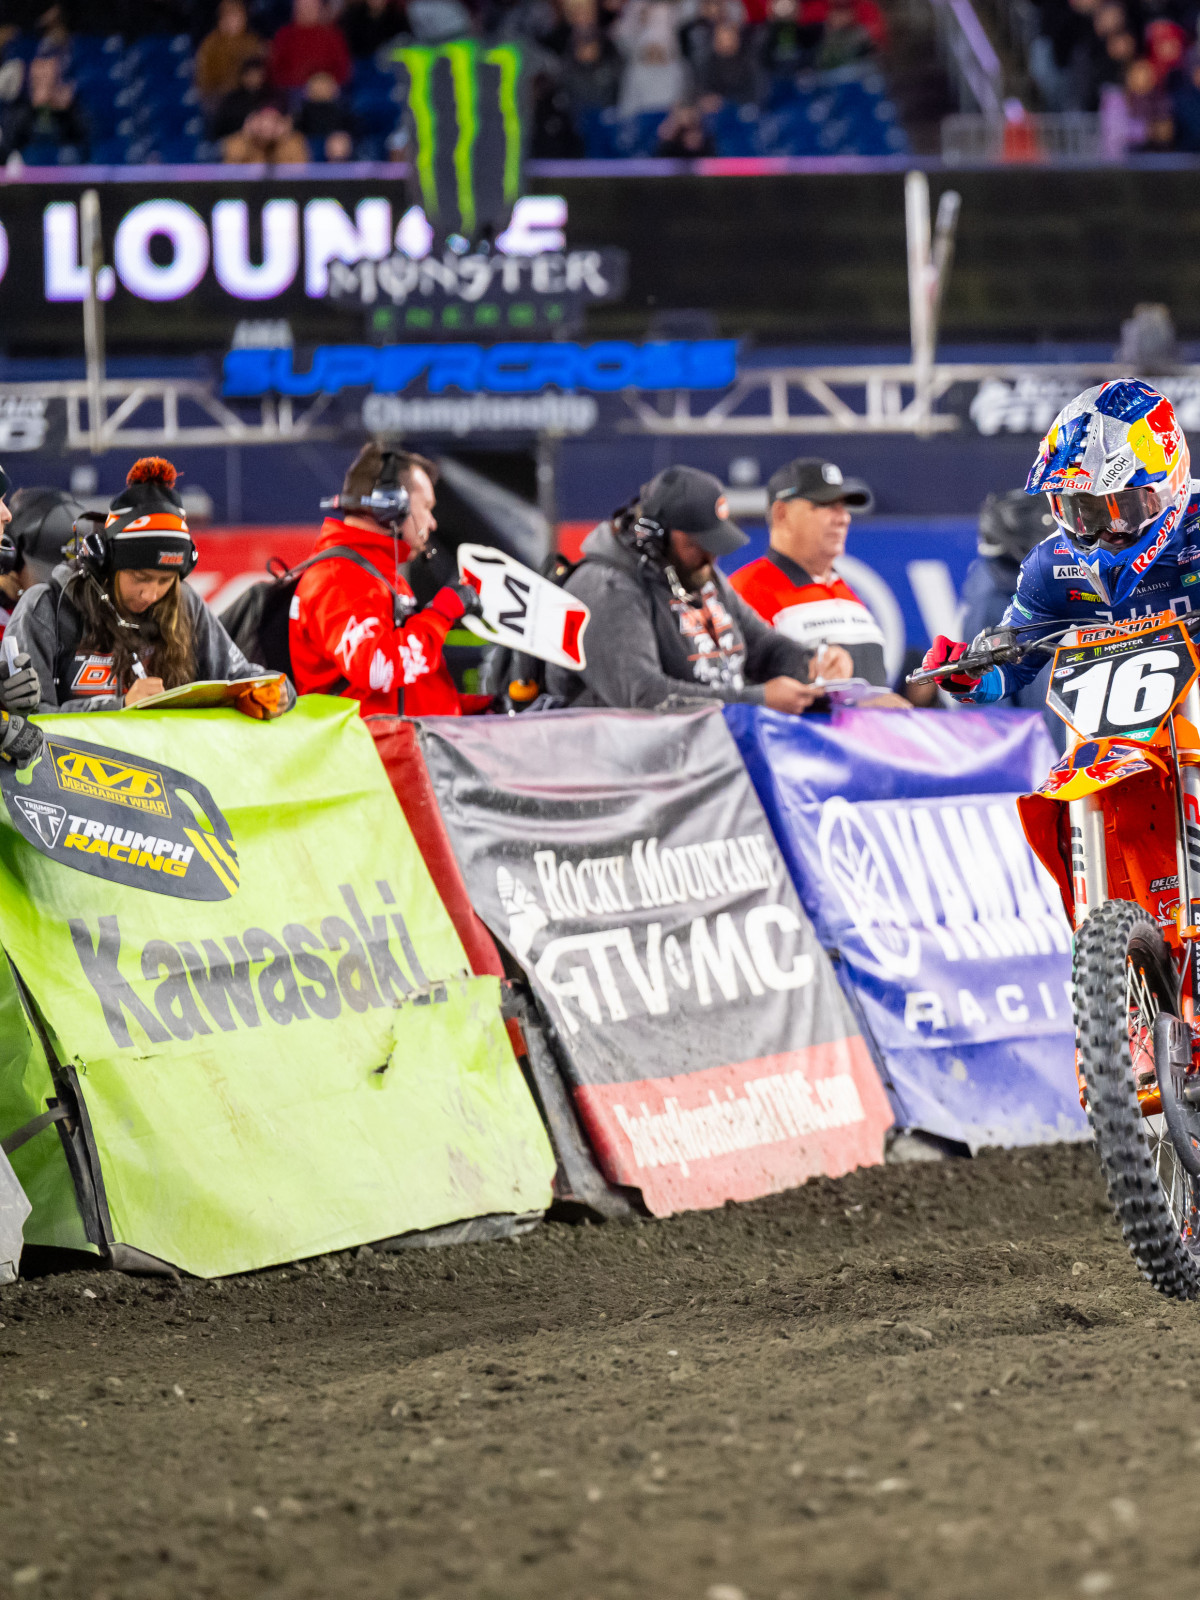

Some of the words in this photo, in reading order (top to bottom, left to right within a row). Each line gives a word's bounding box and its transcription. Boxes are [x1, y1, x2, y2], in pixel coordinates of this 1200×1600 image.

[328, 250, 606, 302] MONSTER
[1040, 479, 1065, 491] Red
[1066, 479, 1092, 491] Bull
[1102, 455, 1130, 488] AIROH
[1131, 527, 1168, 575] Red
[1081, 618, 1166, 644] RENTHAL
[1104, 638, 1144, 652] MONSTER
[1061, 650, 1180, 738] 16
[61, 773, 127, 804] MECHANIX
[129, 795, 167, 815] WEAR
[63, 832, 189, 878] RACING
[67, 814, 195, 864] TRIUMPH
[534, 850, 634, 920] ROCKY
[631, 837, 780, 907] MOUNTAIN
[68, 880, 448, 1048] Kawasaki
[904, 984, 1077, 1032] RACI
